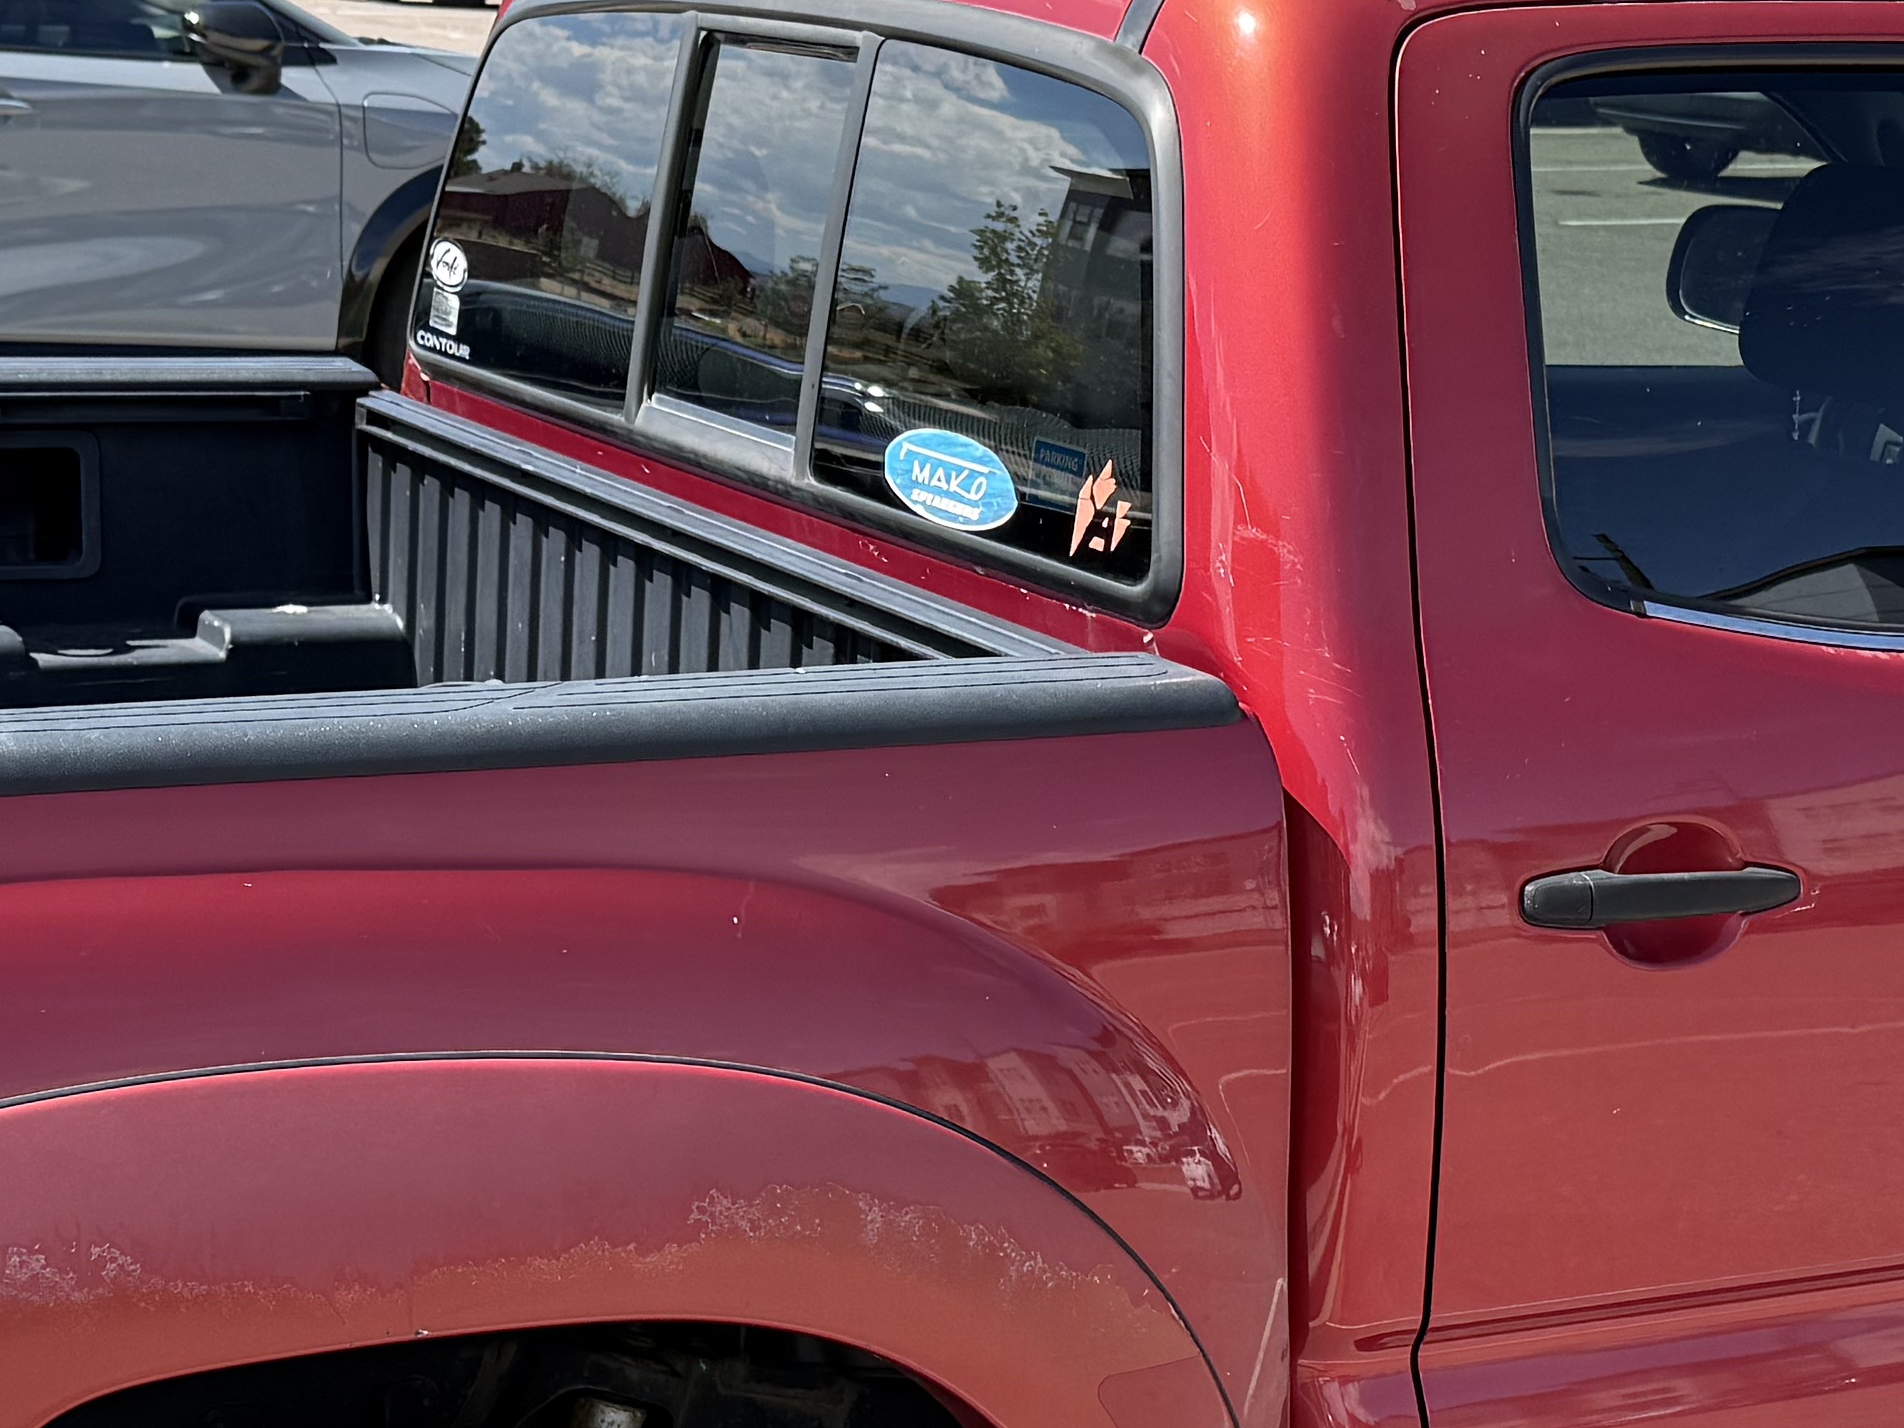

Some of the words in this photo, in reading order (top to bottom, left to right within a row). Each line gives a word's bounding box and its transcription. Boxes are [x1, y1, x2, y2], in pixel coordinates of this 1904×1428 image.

[416, 330, 471, 360] CONTOUR
[1039, 448, 1079, 471] PARKING
[912, 460, 987, 500] MAKO
